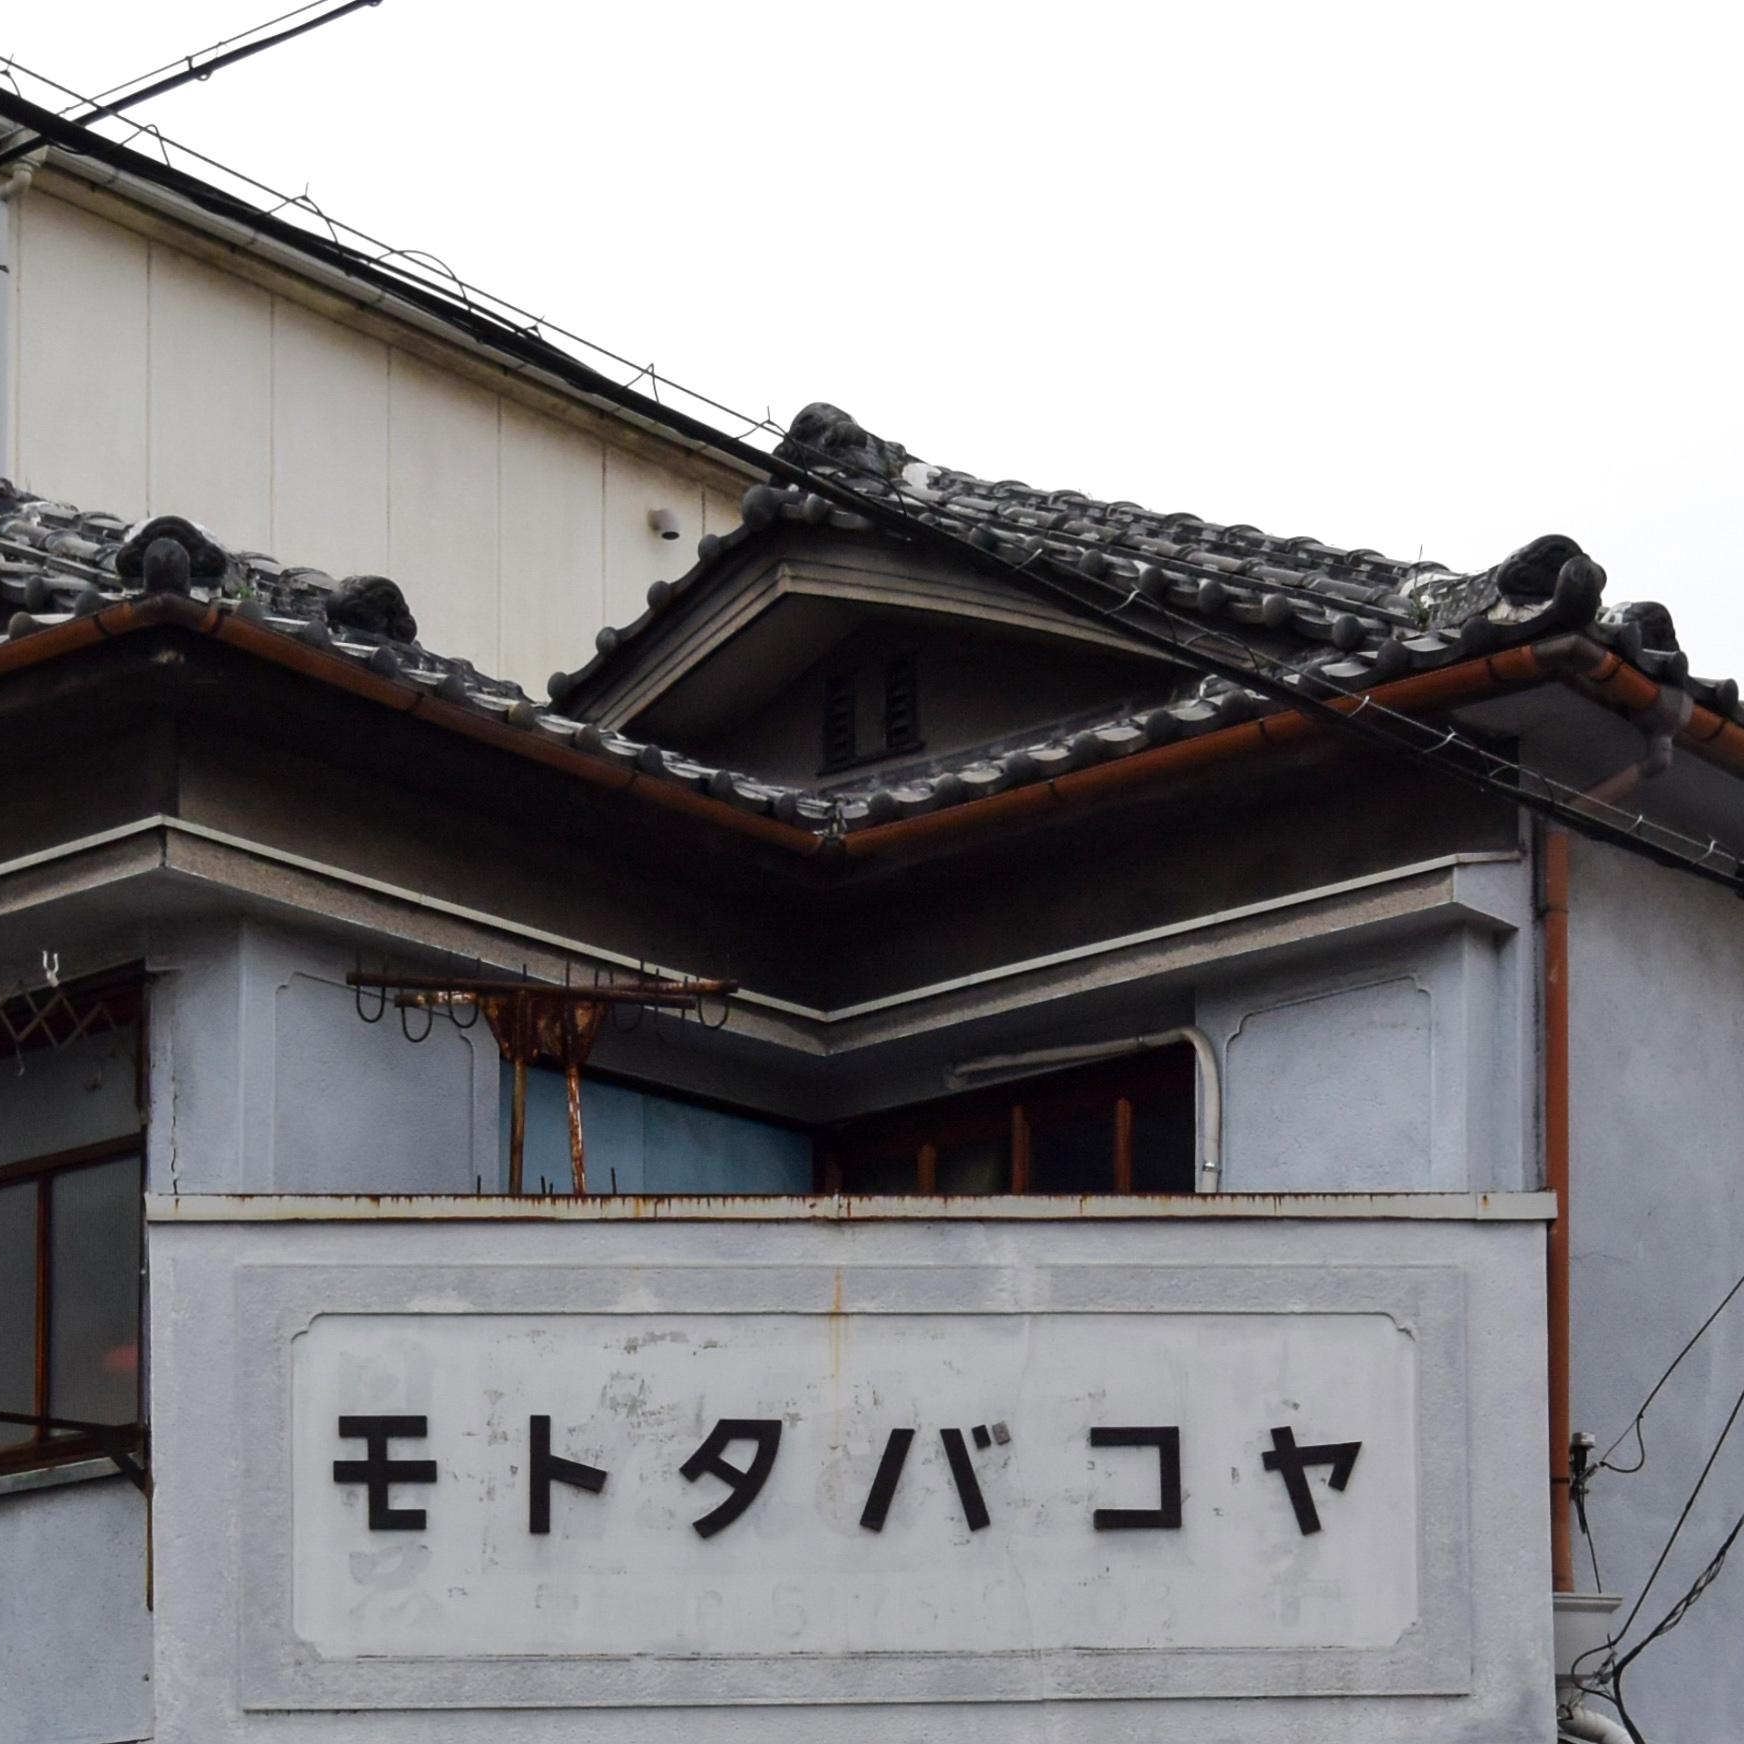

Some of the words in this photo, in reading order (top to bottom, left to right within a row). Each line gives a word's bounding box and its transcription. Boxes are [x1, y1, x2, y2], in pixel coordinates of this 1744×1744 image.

[332, 1414, 1363, 1541] モトタバコヤ
